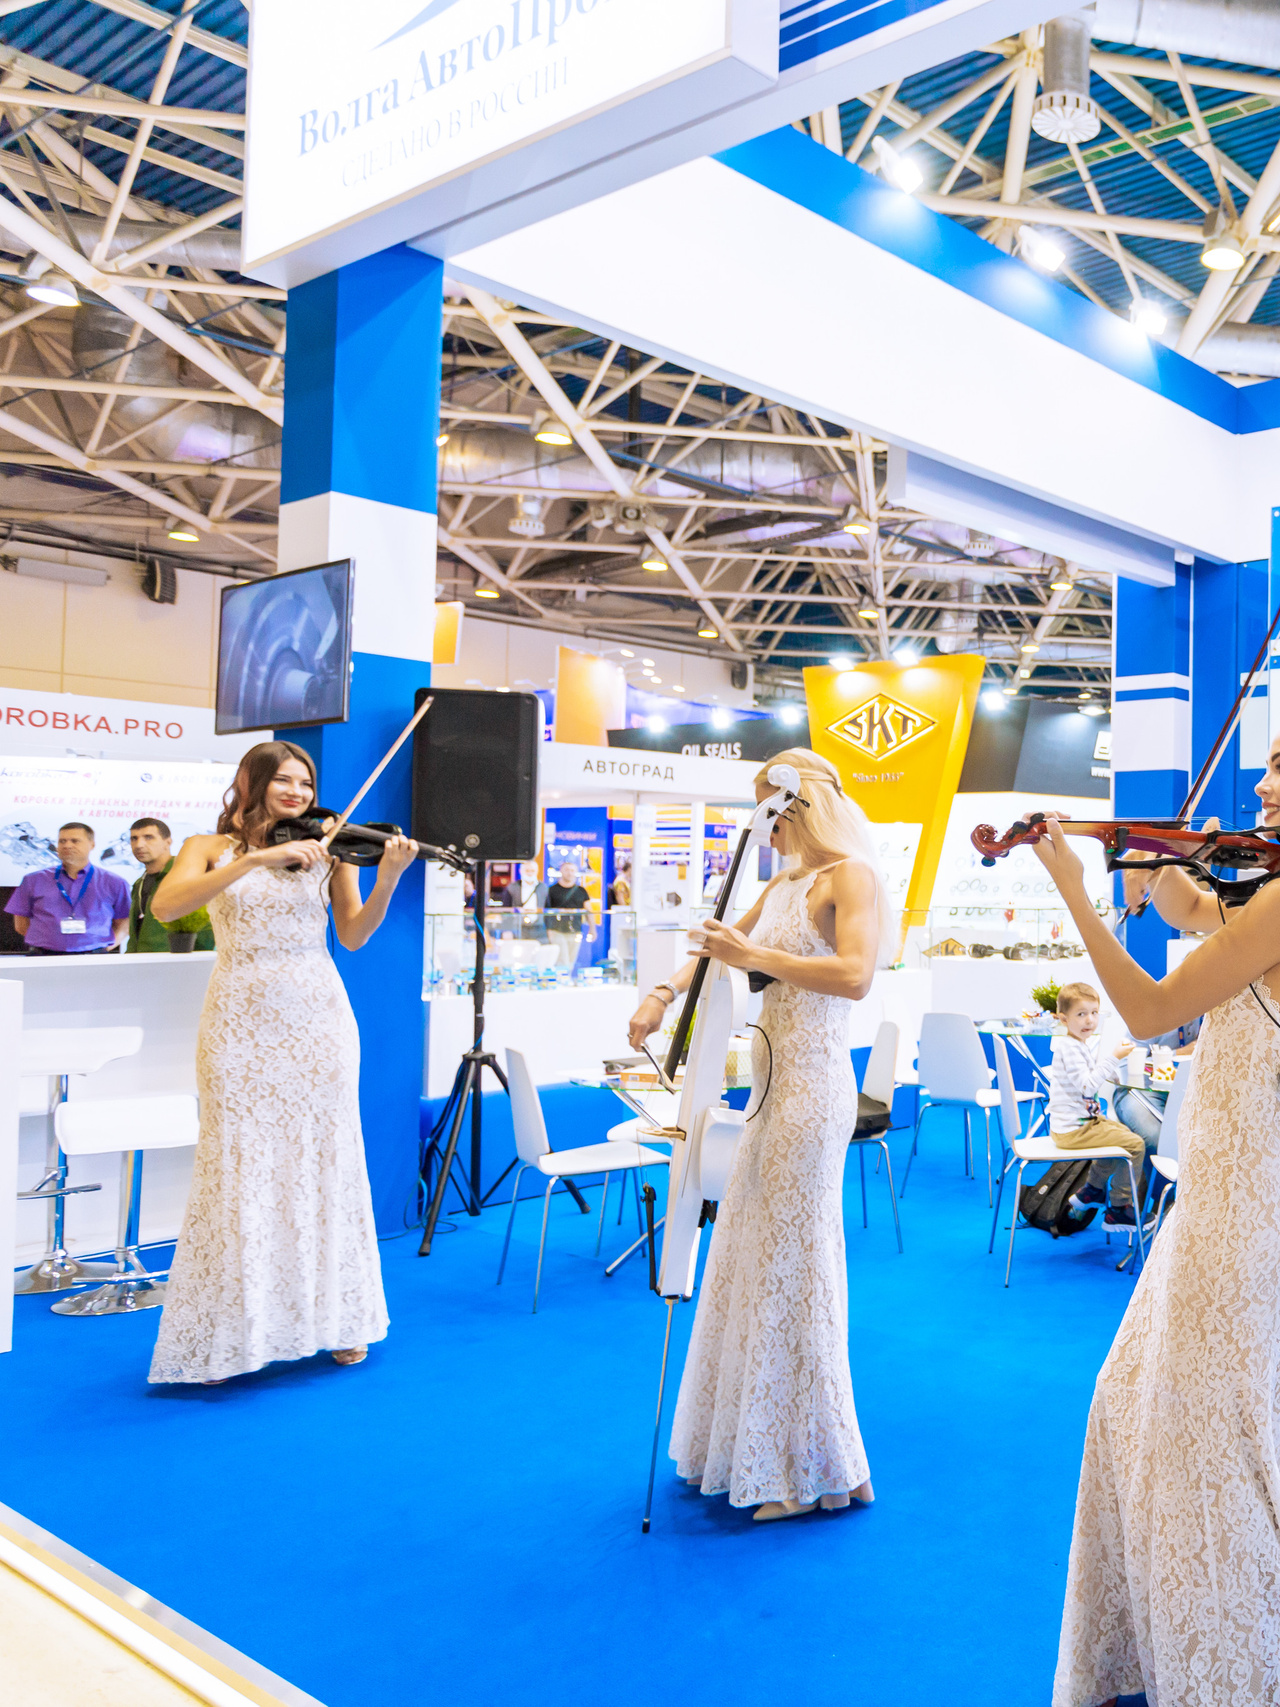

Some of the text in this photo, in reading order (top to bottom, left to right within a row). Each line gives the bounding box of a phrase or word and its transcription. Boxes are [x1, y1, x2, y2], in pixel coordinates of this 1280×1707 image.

[297, 77, 401, 157] Волга
[448, 109, 461, 139] В
[0, 707, 184, 739] ROBKA.PRO
[843, 702, 921, 751] SKT
[703, 742, 743, 760] SEALS
[583, 759, 675, 781] АВТОГРАД
